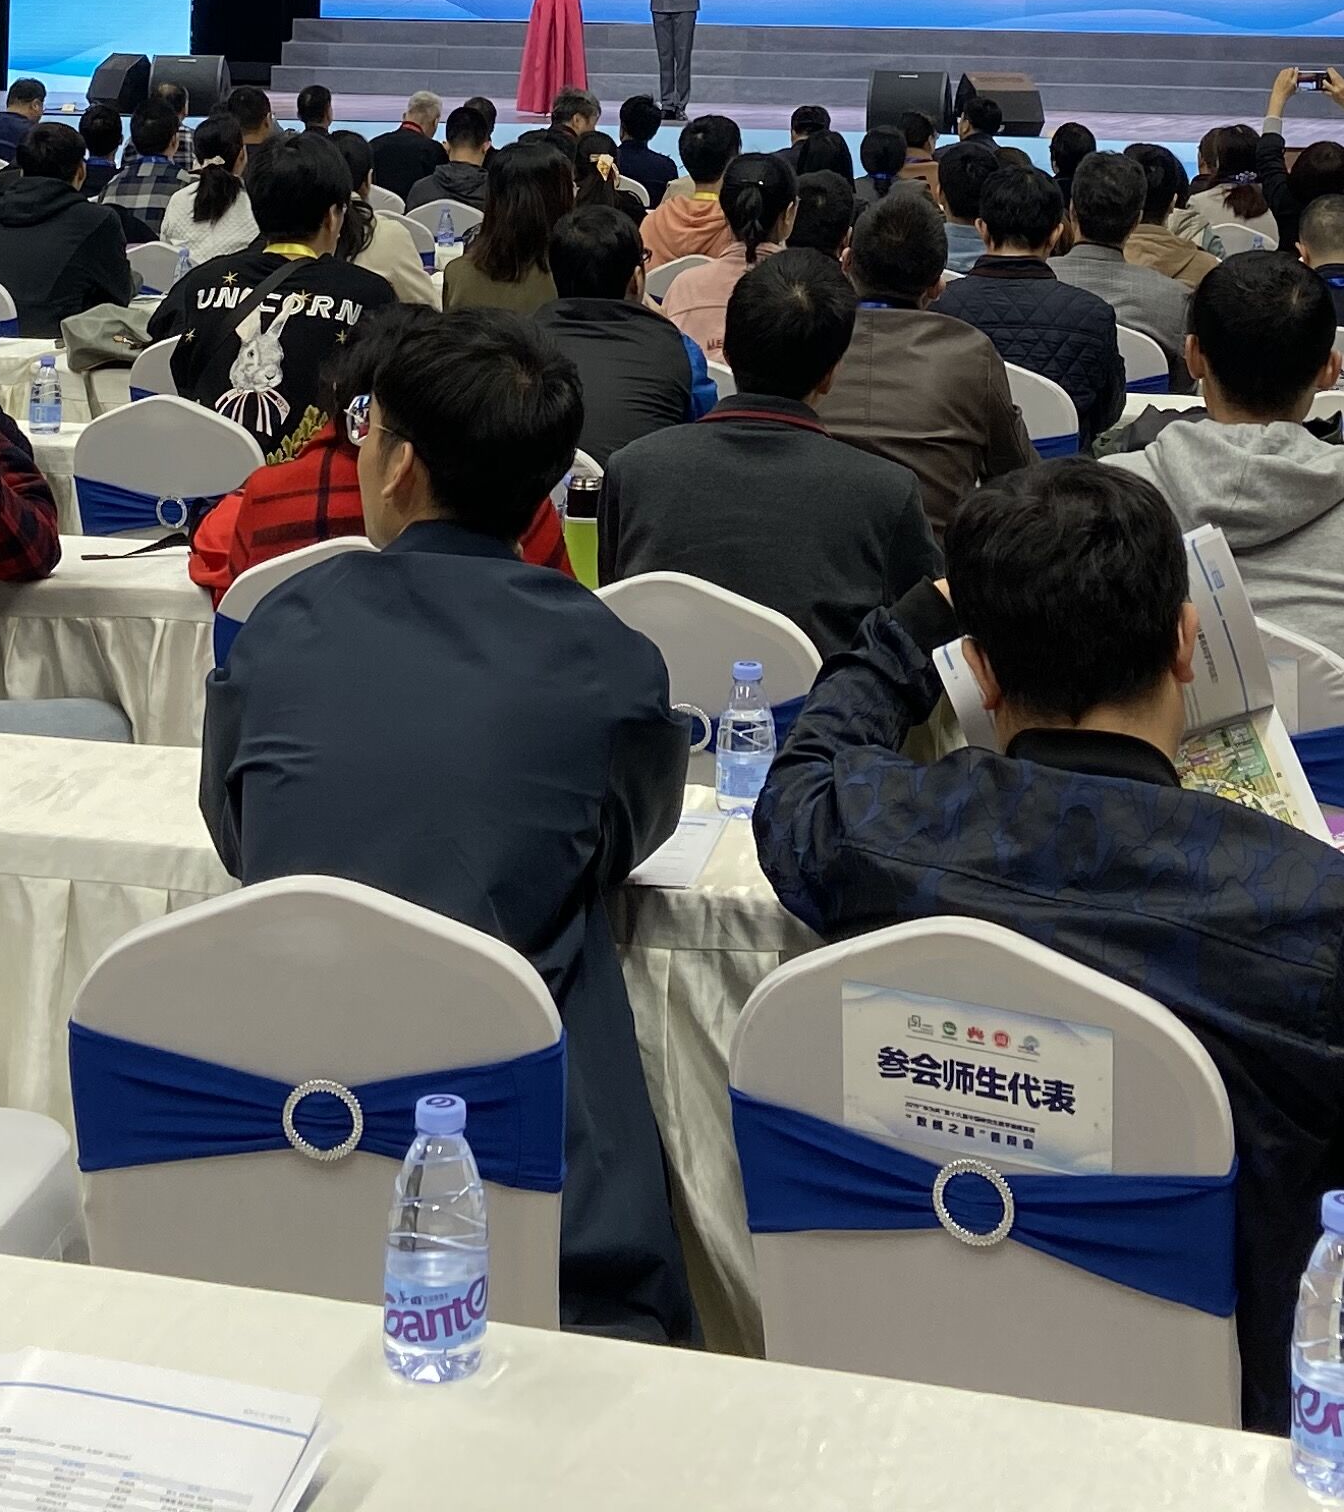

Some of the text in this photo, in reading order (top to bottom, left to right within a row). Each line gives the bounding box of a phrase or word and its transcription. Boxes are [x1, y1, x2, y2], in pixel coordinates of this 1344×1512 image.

[197, 287, 363, 326] UNCORN
[877, 1045, 1077, 1116] 参会师生代表
